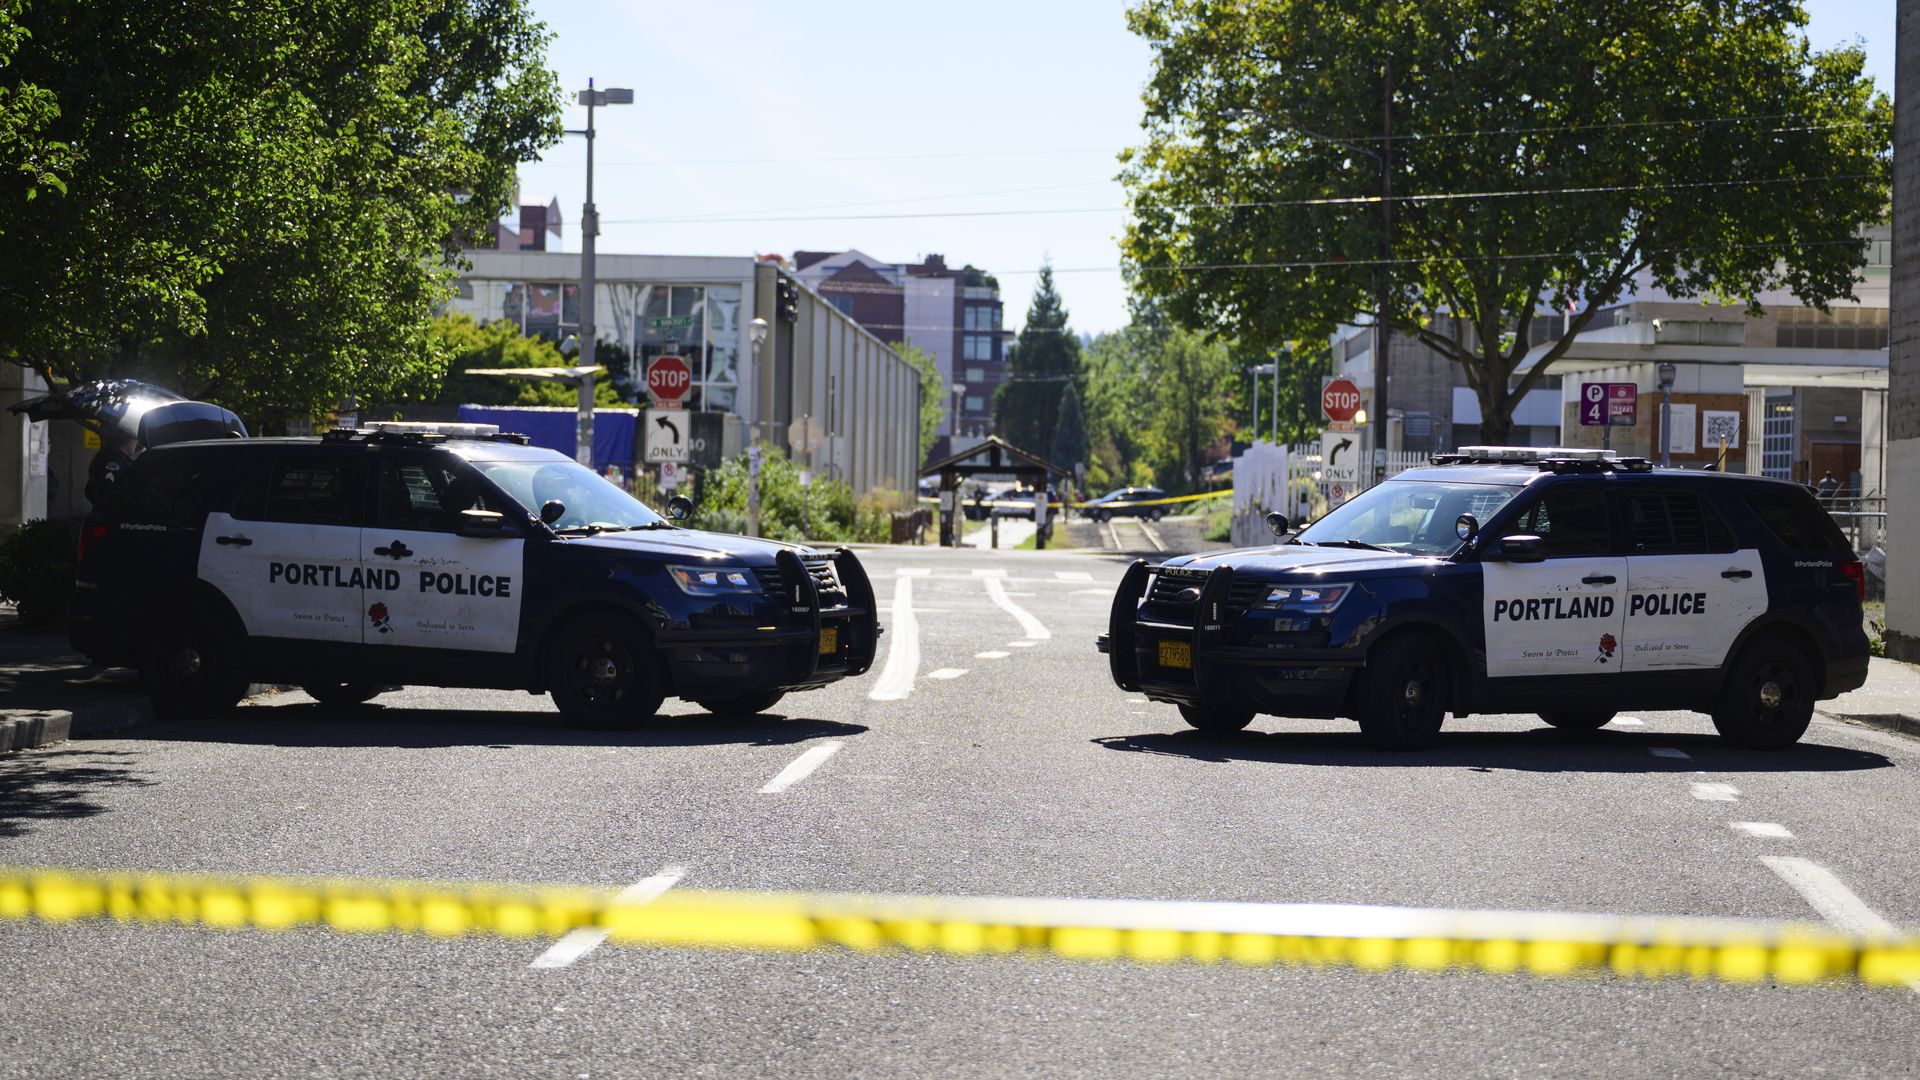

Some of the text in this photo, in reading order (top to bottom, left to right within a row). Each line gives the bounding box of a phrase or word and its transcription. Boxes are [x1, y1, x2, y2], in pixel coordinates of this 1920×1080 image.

[650, 370, 689, 387] STOP
[1591, 387, 1600, 400] P
[1325, 392, 1359, 409] STOP
[1589, 404, 1600, 419] 4
[652, 447, 683, 457] ONLY
[1326, 468, 1354, 478] ONLY
[1165, 568, 1192, 576] POLICE
[269, 562, 511, 598] PORTLAND POLICE
[1493, 592, 1706, 622] PORTLAND POLICE
[1633, 642, 1664, 652] Dedicated
[1522, 650, 1544, 658] Sworn
